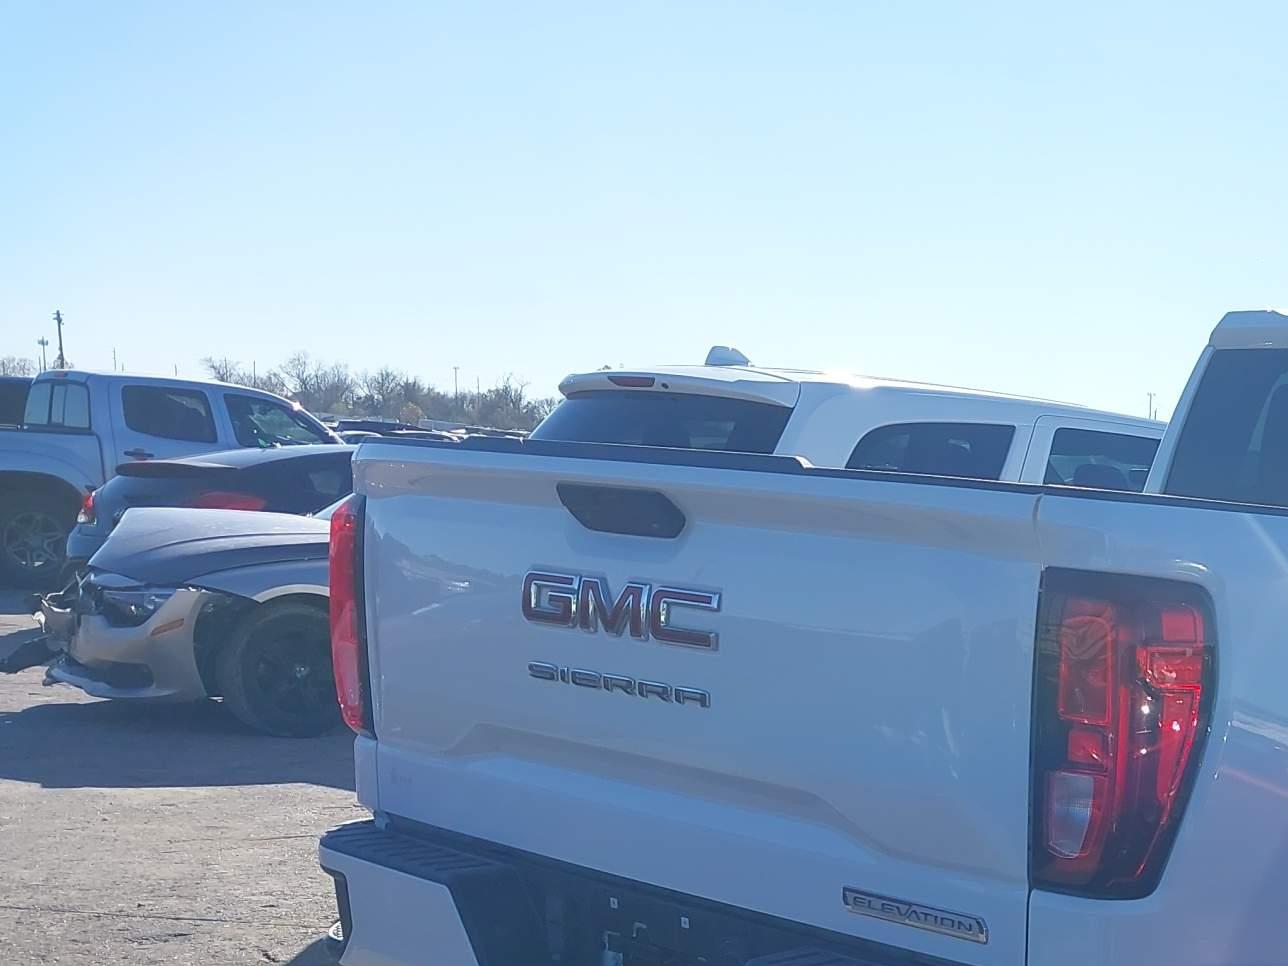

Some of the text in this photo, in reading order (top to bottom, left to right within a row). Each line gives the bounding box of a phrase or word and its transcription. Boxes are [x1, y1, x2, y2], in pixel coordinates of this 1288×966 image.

[521, 570, 722, 651] GMC
[527, 660, 711, 709] SIERRA
[853, 896, 973, 932] ELEVATION
